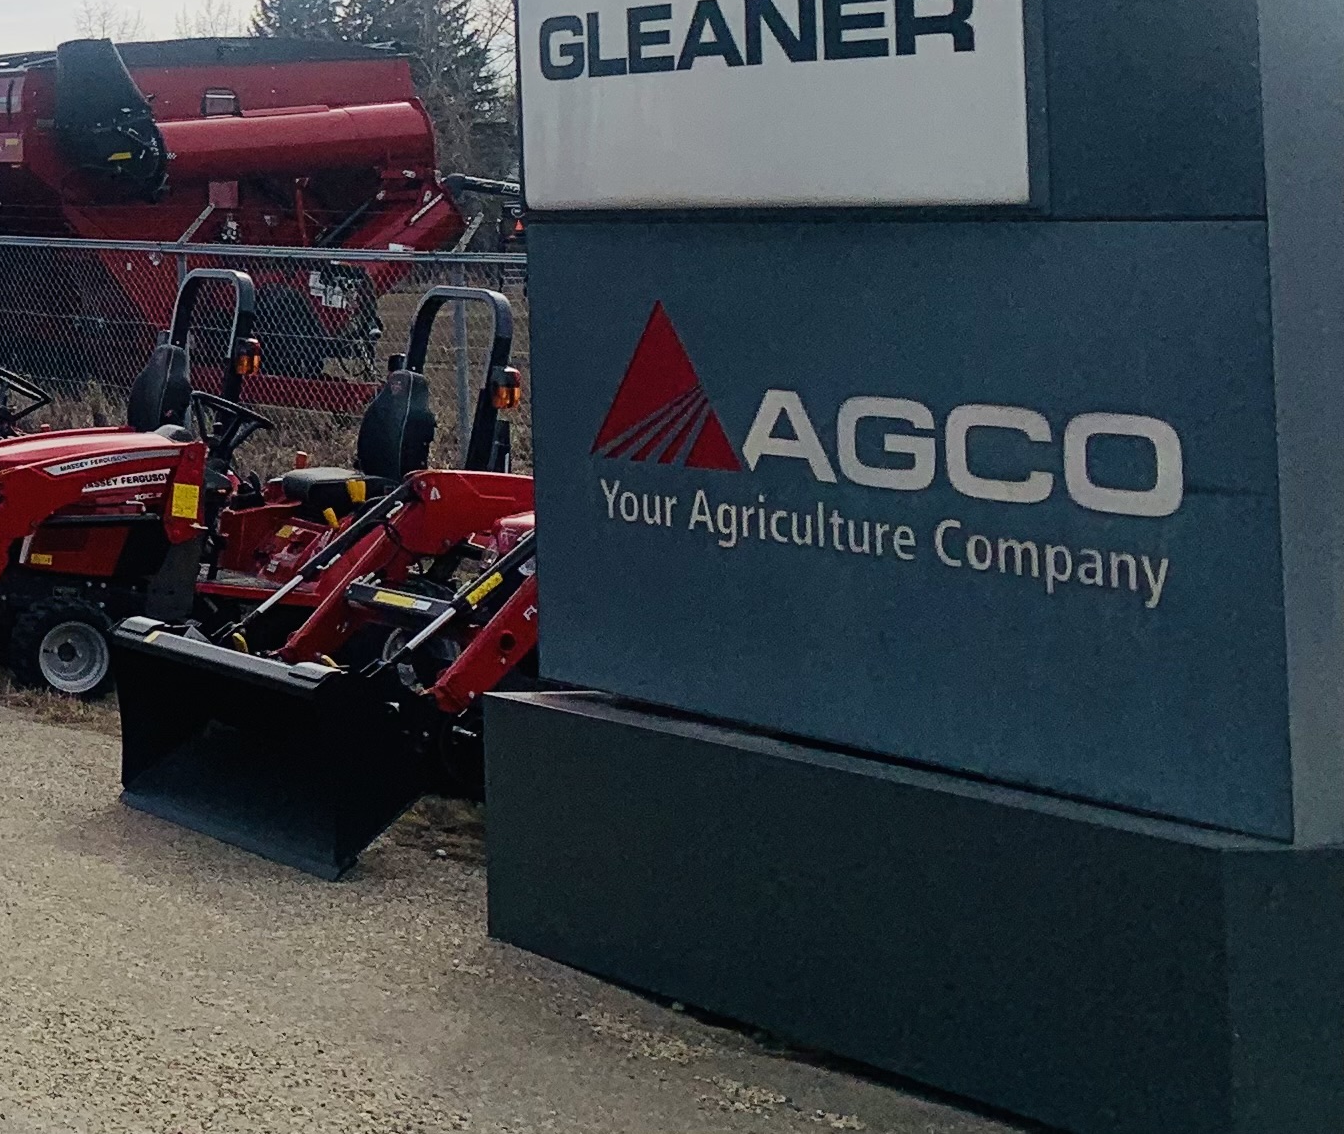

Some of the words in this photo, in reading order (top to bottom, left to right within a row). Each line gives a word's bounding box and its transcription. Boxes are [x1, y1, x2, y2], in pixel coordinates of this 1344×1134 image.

[59, 461, 89, 472] MASSEY
[90, 454, 129, 466] FERGUSON
[742, 387, 1184, 519] AGCO
[600, 478, 678, 529] Your
[688, 488, 917, 561] Agriculture
[934, 518, 1171, 609] Company
